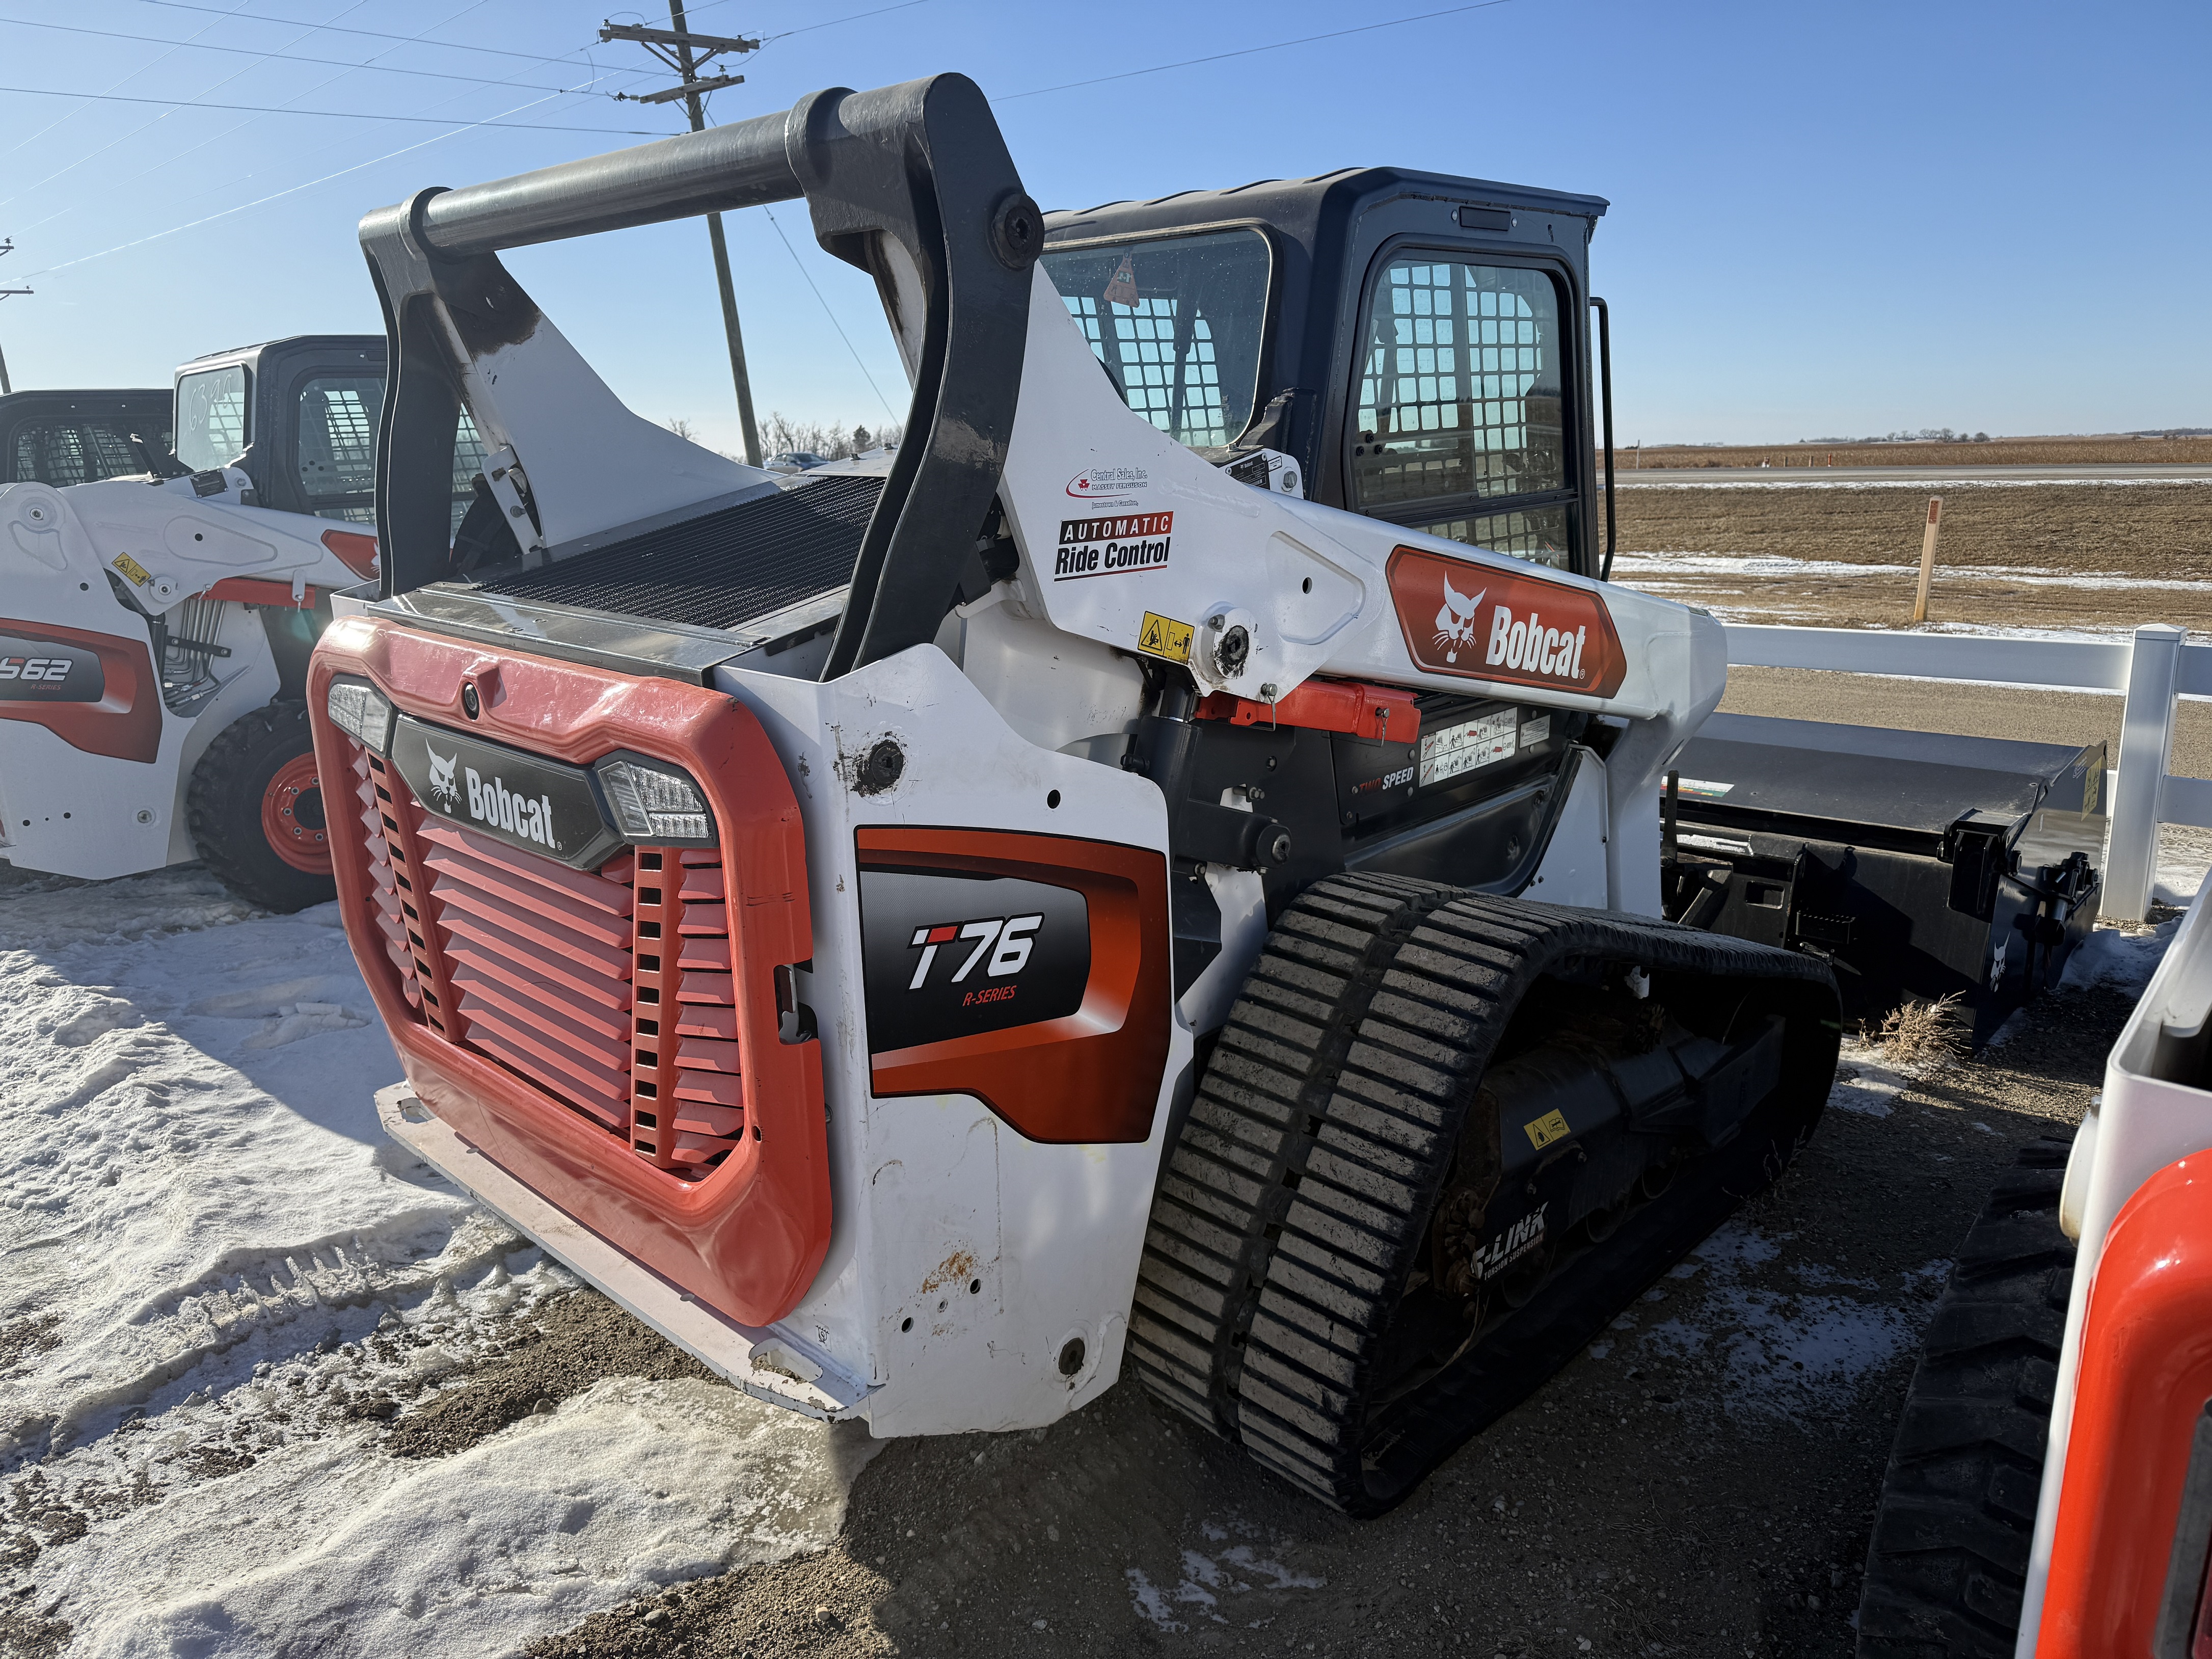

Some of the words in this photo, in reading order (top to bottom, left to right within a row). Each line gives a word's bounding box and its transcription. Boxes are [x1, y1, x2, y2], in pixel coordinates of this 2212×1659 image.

[1091, 469, 1115, 481] Central
[1117, 468, 1135, 480] Sales,
[1136, 468, 1147, 479] Inc.
[1064, 516, 1169, 541] AUTOMATIC
[1055, 545, 1099, 575] Ride
[1104, 537, 1171, 569] Control
[0, 657, 72, 681] S62
[1359, 778, 1382, 792] TWO
[1382, 766, 1414, 790] SPEED
[909, 915, 1042, 989] T76
[962, 985, 1017, 1007] R-SERIES
[1484, 1256, 1508, 1281] TORSION
[1509, 1233, 1544, 1262] SUSPENSION
